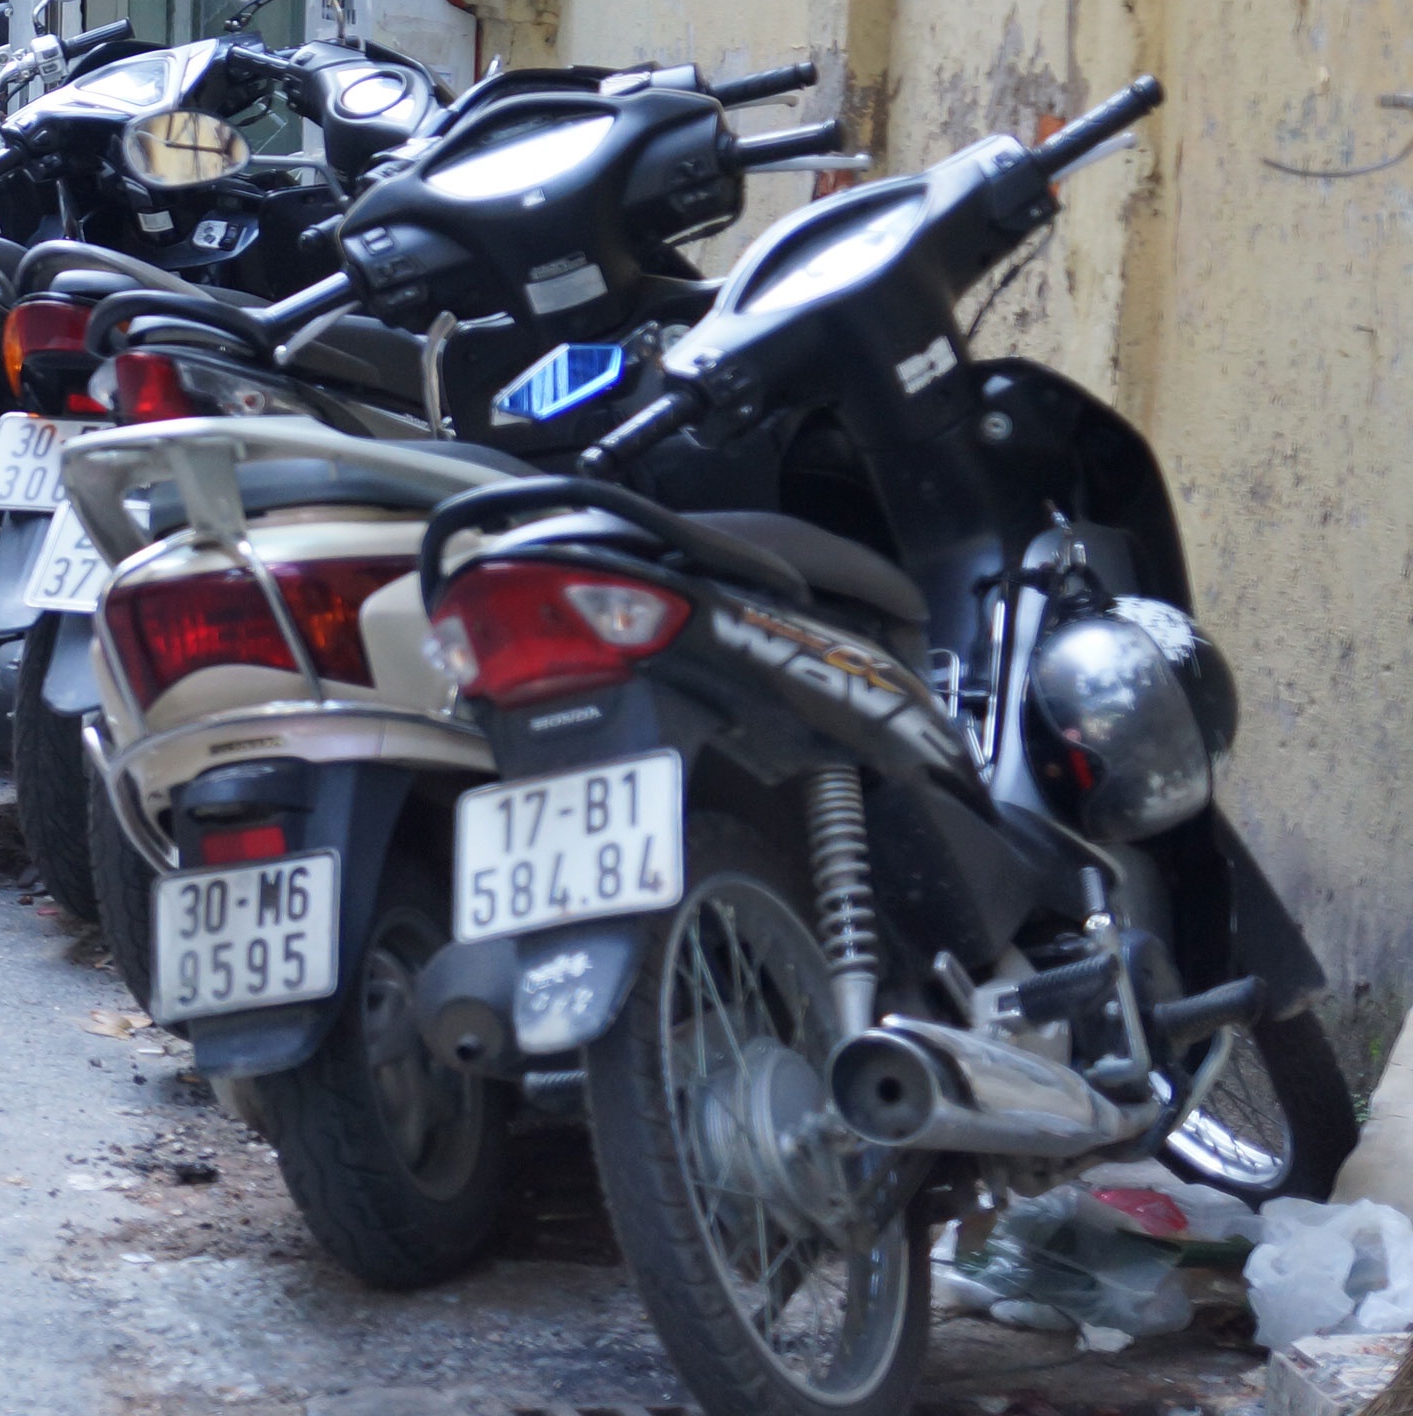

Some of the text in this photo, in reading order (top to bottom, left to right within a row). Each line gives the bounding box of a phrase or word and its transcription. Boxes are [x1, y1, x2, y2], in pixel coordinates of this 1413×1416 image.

[498, 771, 640, 854] 17-B1
[179, 866, 310, 939] 30-M6
[472, 835, 667, 927] 584.84
[178, 932, 308, 1008] 9595
